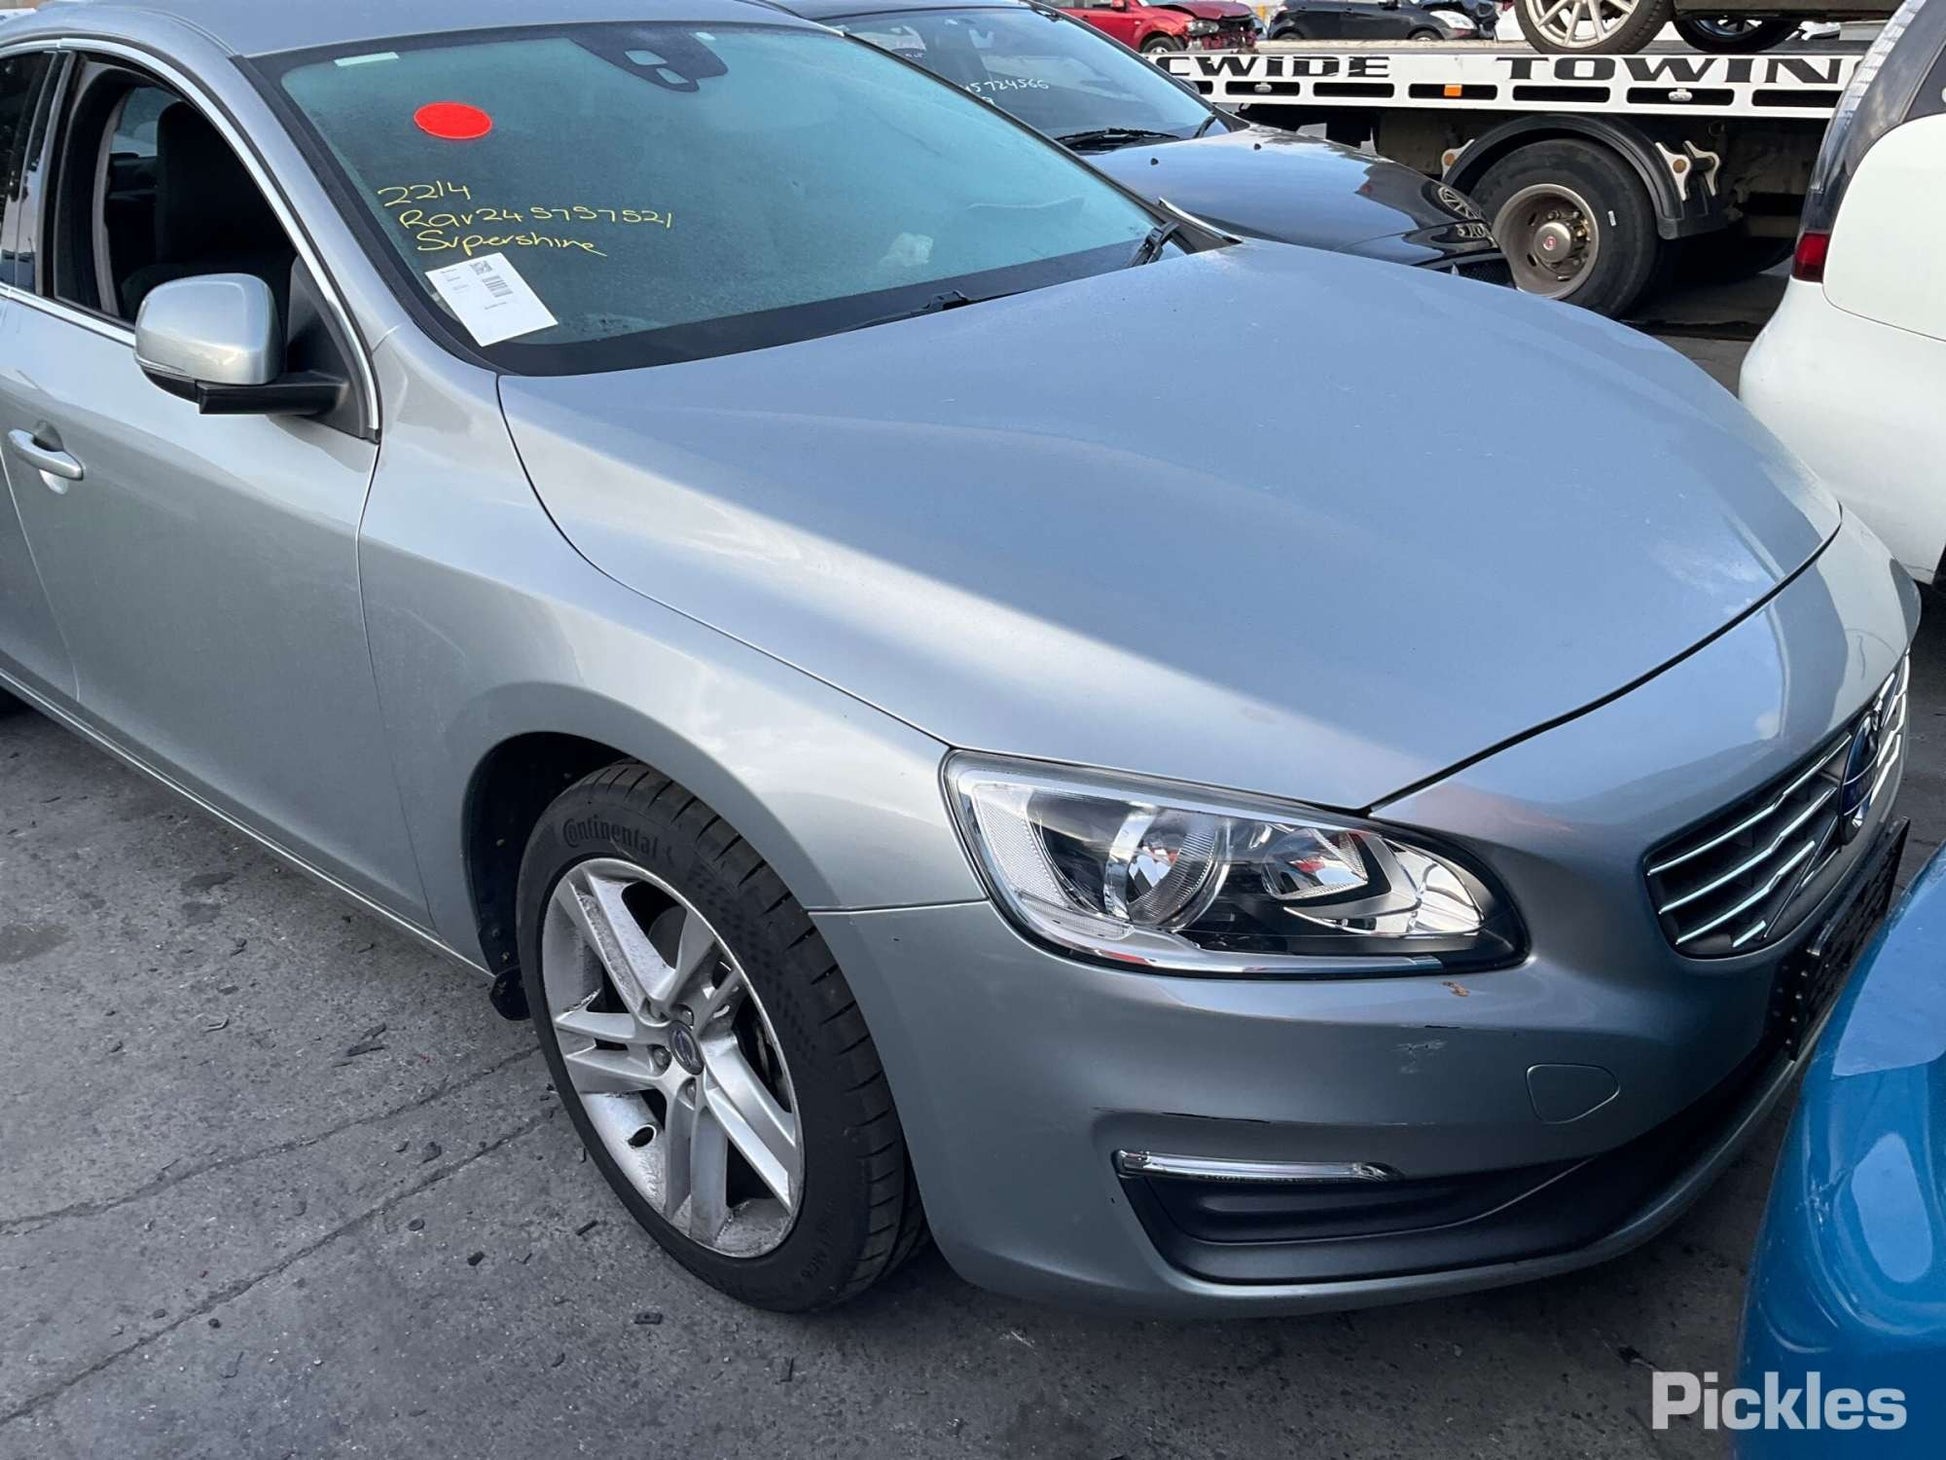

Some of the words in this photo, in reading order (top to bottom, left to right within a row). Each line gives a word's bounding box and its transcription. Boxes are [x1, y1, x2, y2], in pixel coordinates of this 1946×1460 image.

[1145, 56, 1390, 77] CWIDE
[1496, 57, 1861, 84] TOWIN
[563, 814, 658, 857] Continental
